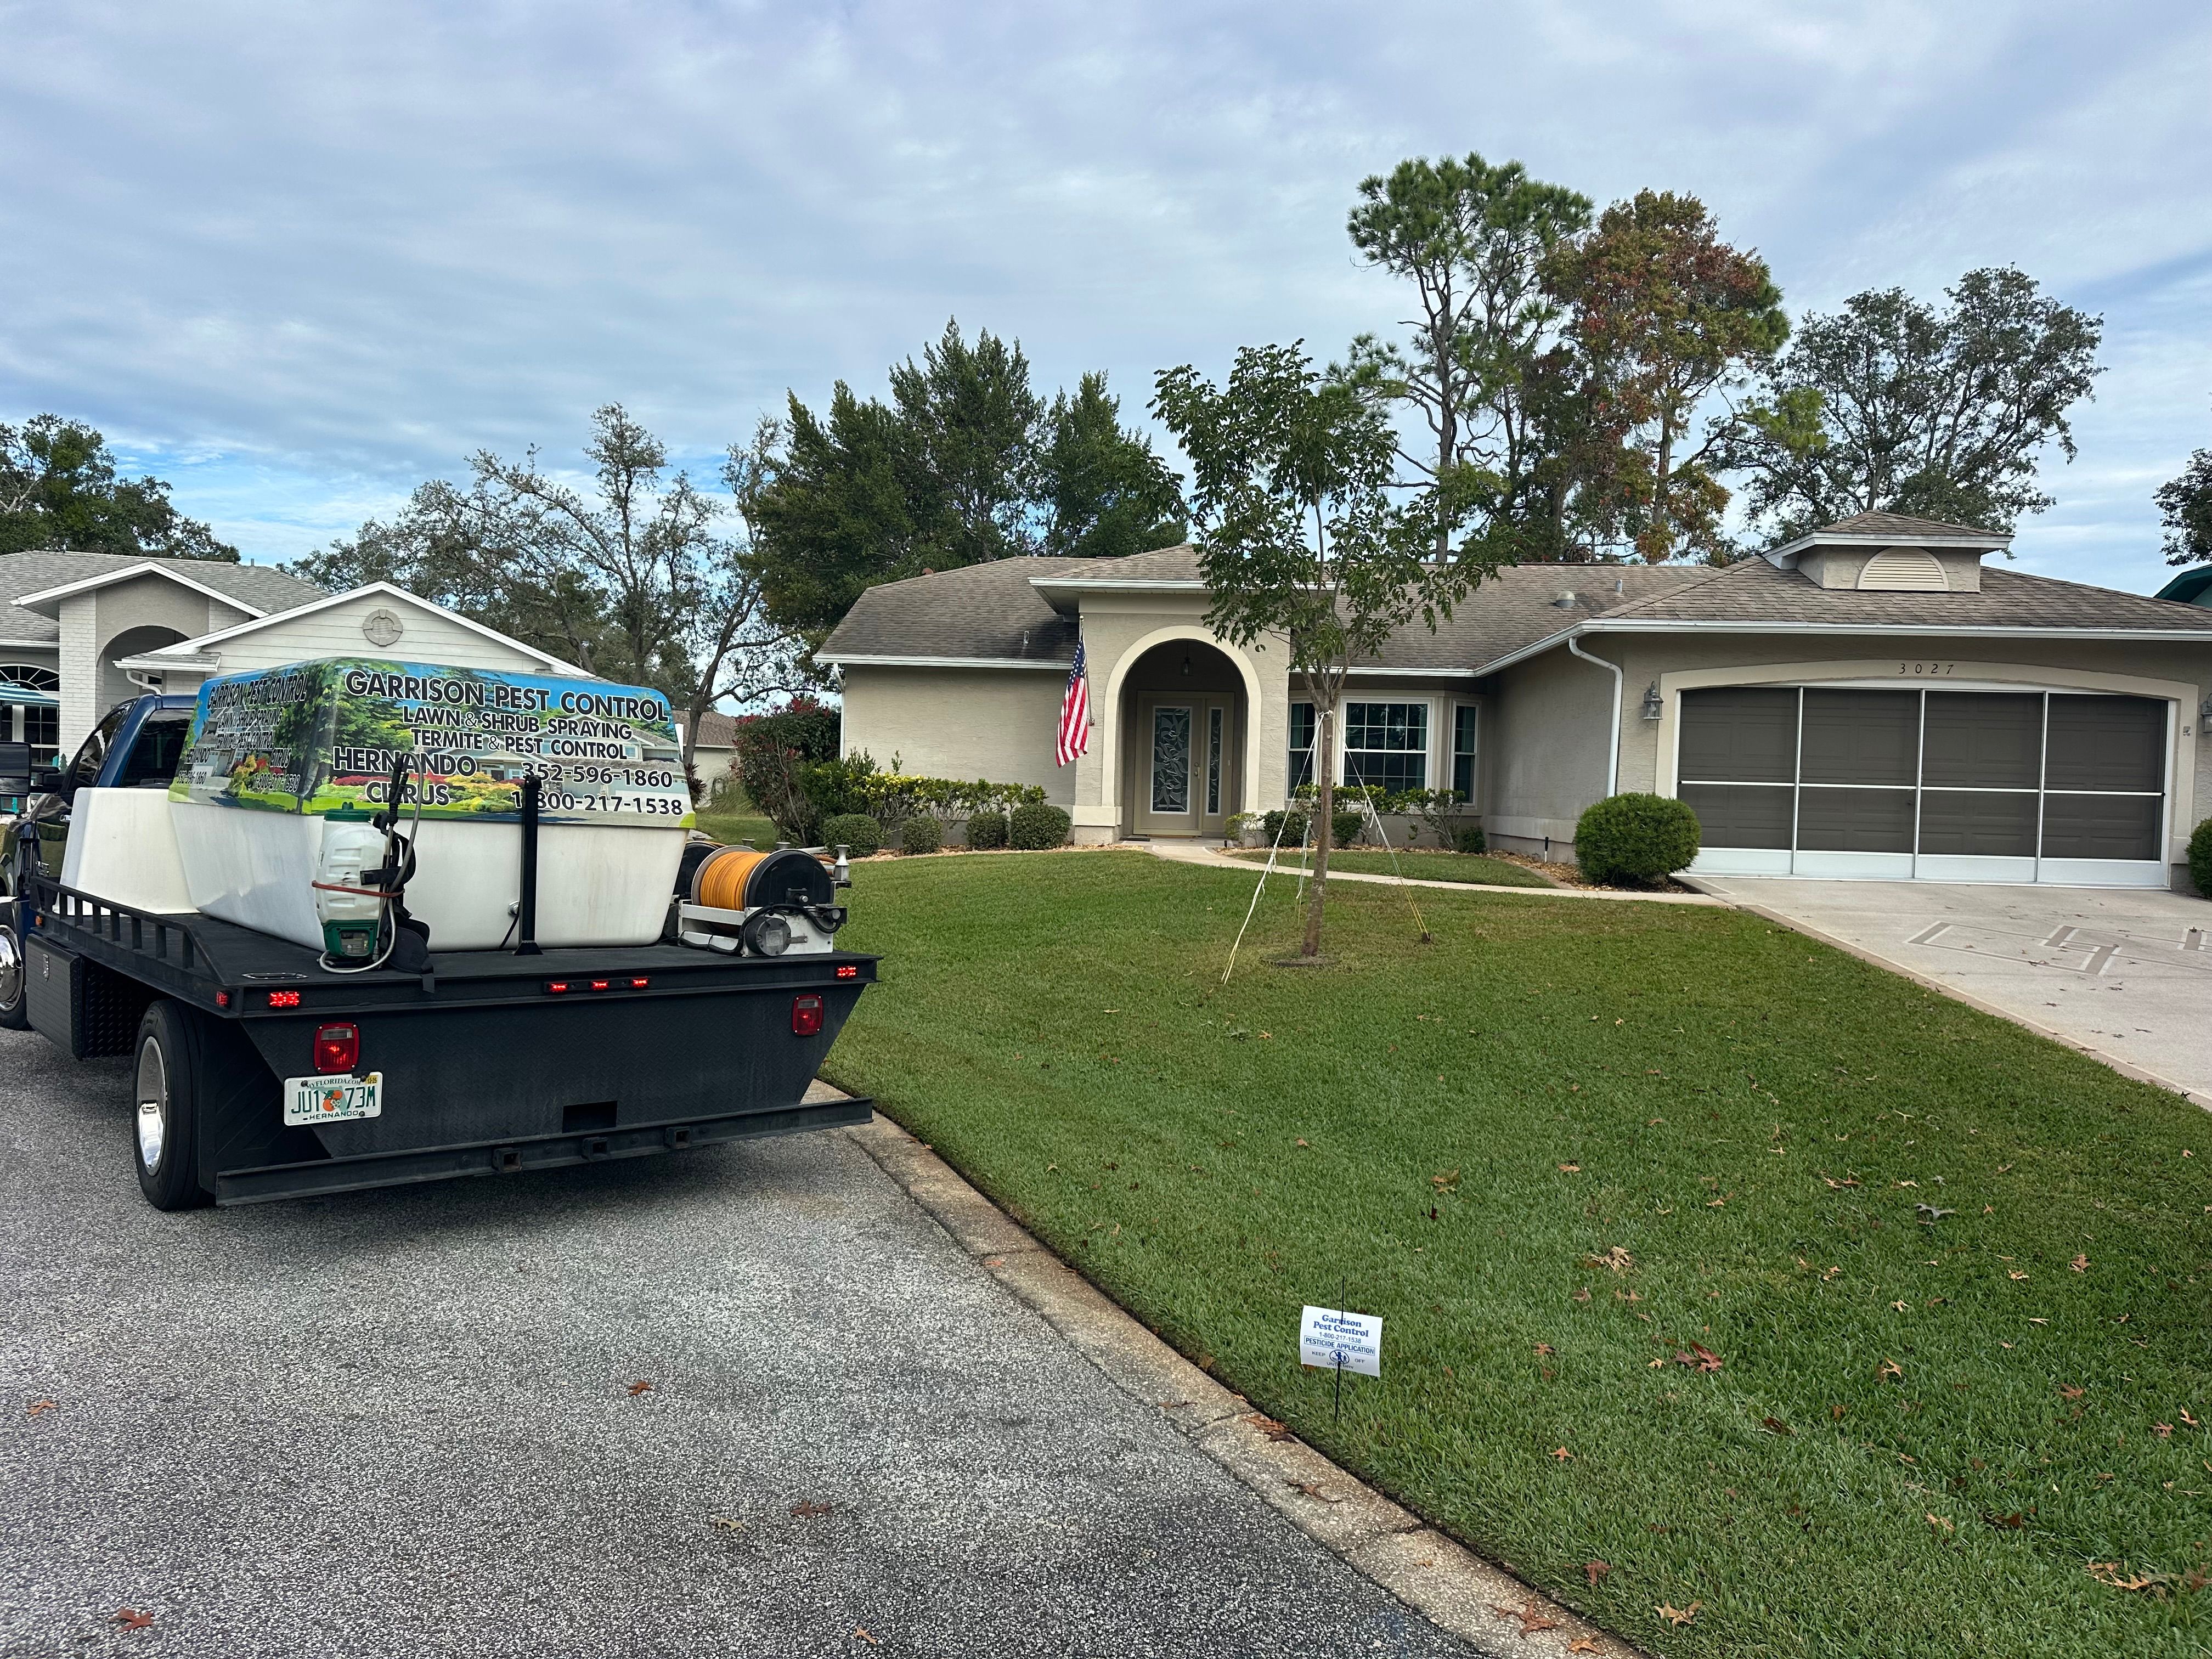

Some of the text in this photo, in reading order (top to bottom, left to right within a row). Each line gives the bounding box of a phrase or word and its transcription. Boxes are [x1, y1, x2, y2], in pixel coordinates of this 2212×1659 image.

[1899, 663, 1954, 675] 3027
[206, 673, 308, 710] GARRISON PEST CONTROL
[345, 670, 669, 723] GARRISON PEST CONTROL
[403, 706, 632, 740] LAWN & SHRUB SPRAYING
[410, 727, 628, 760] TERMITE & PEST CONTROL
[269, 748, 292, 768] CITRUS
[333, 746, 477, 777] HERNANDO
[521, 761, 673, 788] 352-596-1860
[365, 781, 450, 806] CIRUS
[511, 790, 683, 816] 1800-217-1538
[291, 1086, 376, 1114] JU1 73M
[309, 1111, 359, 1120] HERNANDO
[1313, 1321, 1369, 1338] Pest Control
[1322, 1314, 1362, 1328] Garrison
[1305, 1337, 1375, 1355] PESTICIDE APPLICATION
[1319, 1331, 1362, 1344] 1-800-217-1538
